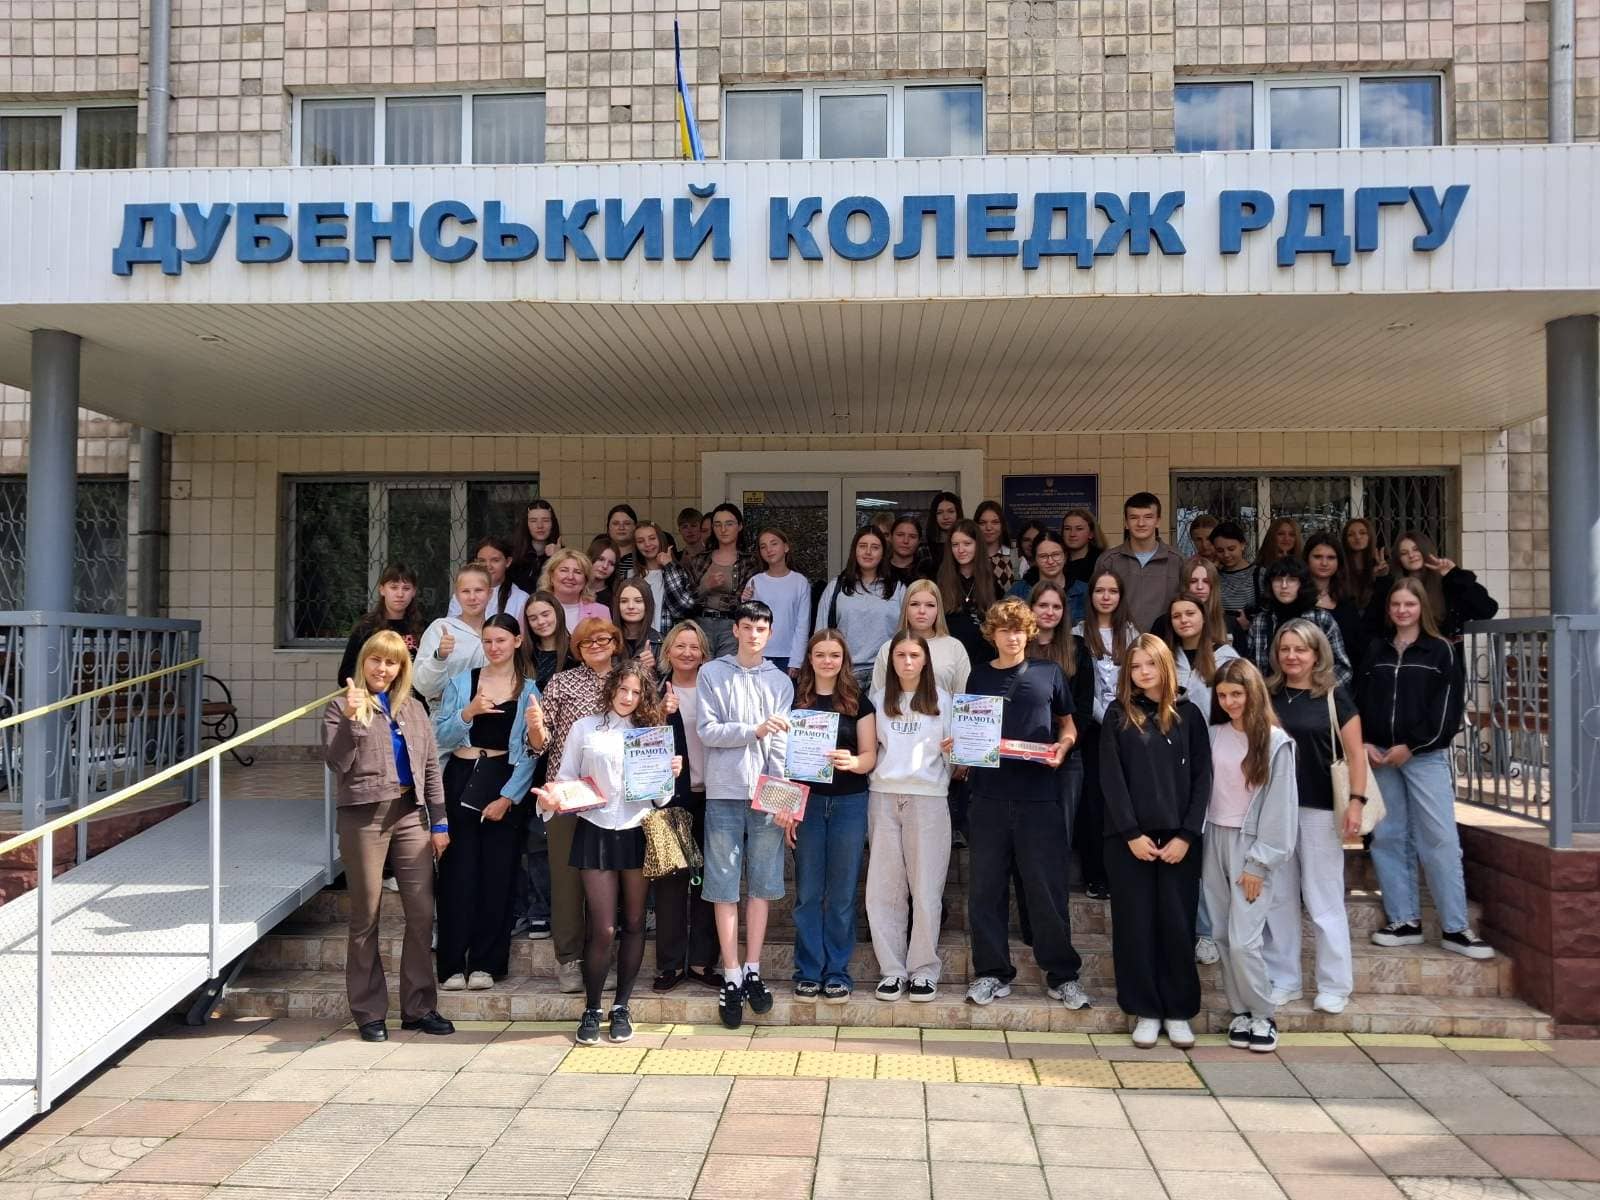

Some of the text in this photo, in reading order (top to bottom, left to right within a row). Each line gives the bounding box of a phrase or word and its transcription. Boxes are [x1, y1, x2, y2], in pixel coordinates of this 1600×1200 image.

[112, 183, 1471, 276] ДУБЕНСЬКИЙ КОЛЕДЖ РДГУ
[958, 714, 995, 724] ГРАМОТА
[793, 729, 830, 740] ГРАМОТА
[630, 747, 668, 758] ГРАМОТА
